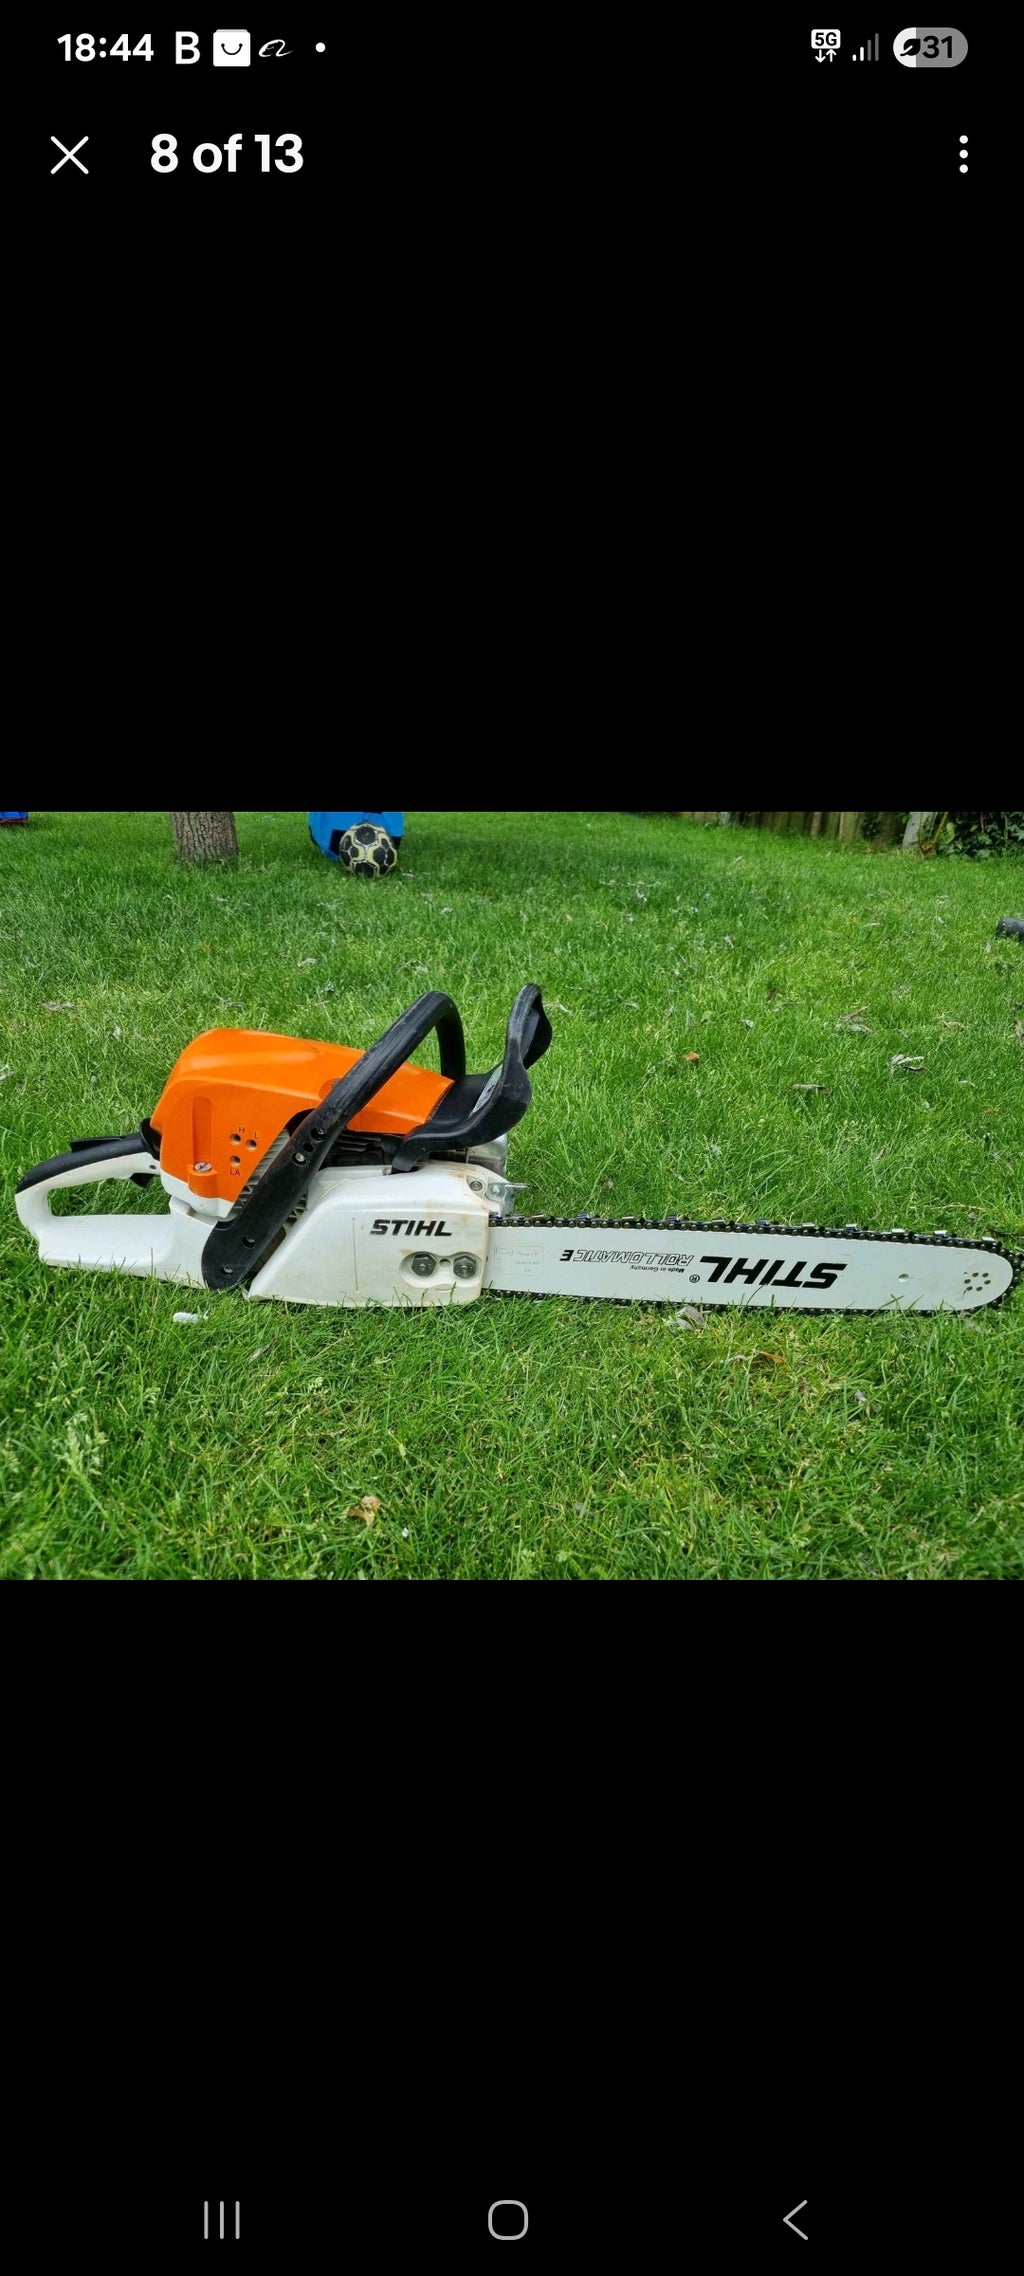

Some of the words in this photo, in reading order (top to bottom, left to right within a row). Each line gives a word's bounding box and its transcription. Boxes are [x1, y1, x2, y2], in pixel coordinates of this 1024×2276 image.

[238, 1126, 246, 1134] H
[254, 1131, 260, 1140] L
[229, 1168, 241, 1176] LA
[369, 1219, 453, 1237] STIHL
[559, 1249, 575, 1262] E
[573, 1249, 695, 1267] ROLLOMATIC
[629, 1265, 659, 1273] Germany
[699, 1255, 848, 1290] STIHL
